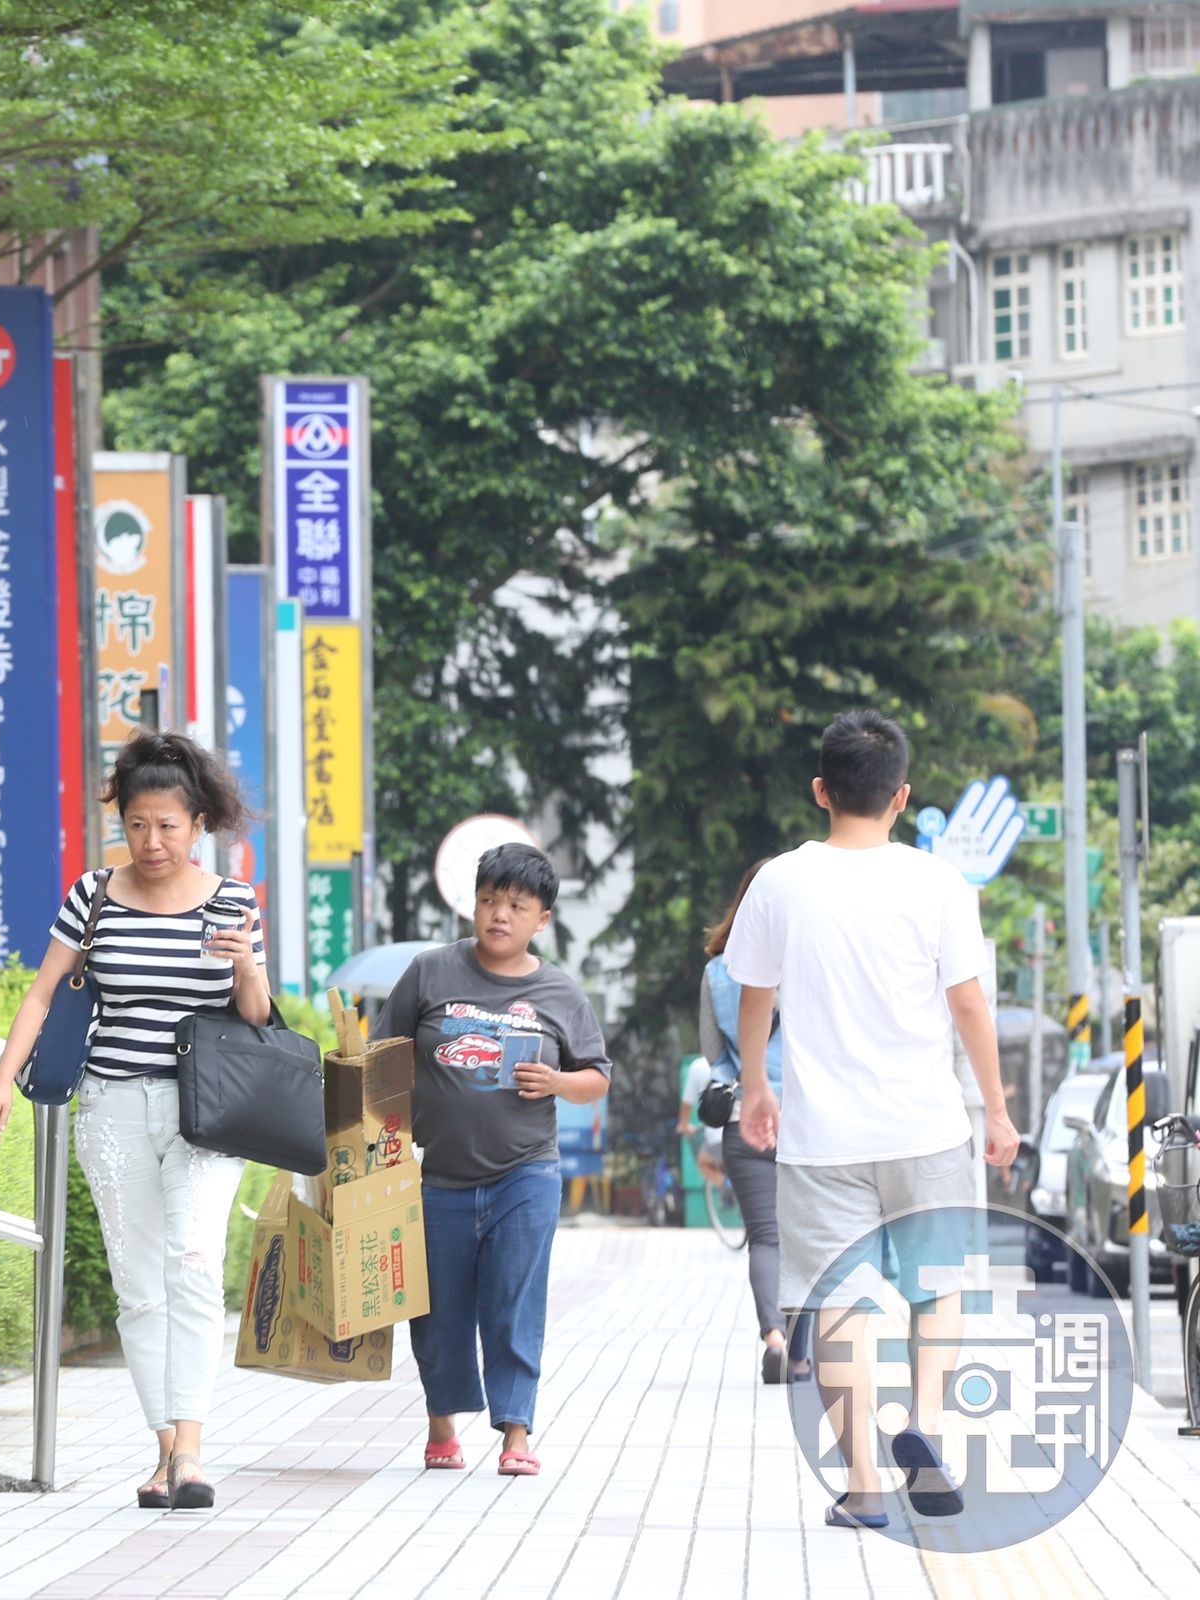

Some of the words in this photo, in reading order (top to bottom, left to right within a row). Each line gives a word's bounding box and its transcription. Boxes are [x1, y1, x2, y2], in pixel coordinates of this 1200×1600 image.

[295, 470, 341, 561] 全聯
[361, 1230, 381, 1318] 黑松茶花
